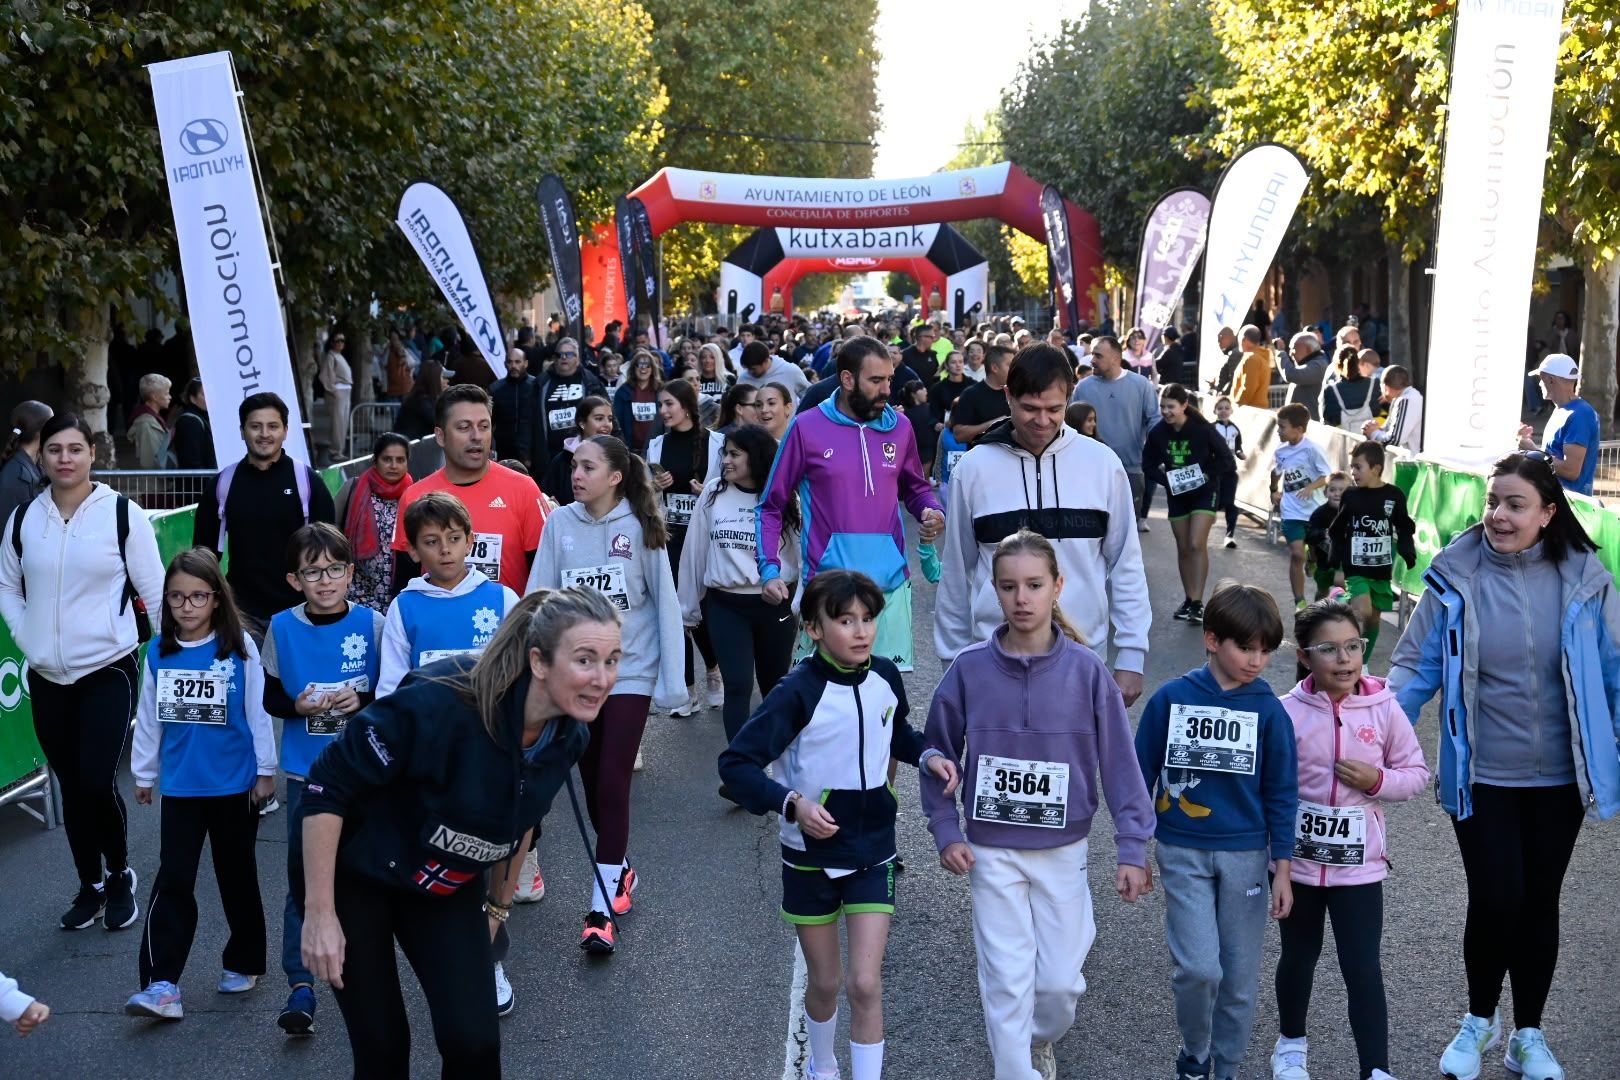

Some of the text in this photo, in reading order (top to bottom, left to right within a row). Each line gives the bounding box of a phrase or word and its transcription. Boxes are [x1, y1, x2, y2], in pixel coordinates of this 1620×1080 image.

[744, 184, 932, 204] AYUNTAMIENTO DE LEÓN
[766, 205, 911, 220] CONCEJALÍA DE DEPORTES
[789, 224, 925, 249] kutxabank
[1231, 172, 1289, 285] HYUNDAI
[604, 257, 617, 314] DEPORTES
[1174, 469, 1196, 482] 3552
[710, 529, 756, 543] WASHINGTO
[1362, 542, 1384, 553] 3177
[173, 678, 215, 699] 3275
[1185, 716, 1241, 743] 3600
[994, 768, 1051, 797] 3564
[1300, 812, 1350, 839] 3574
